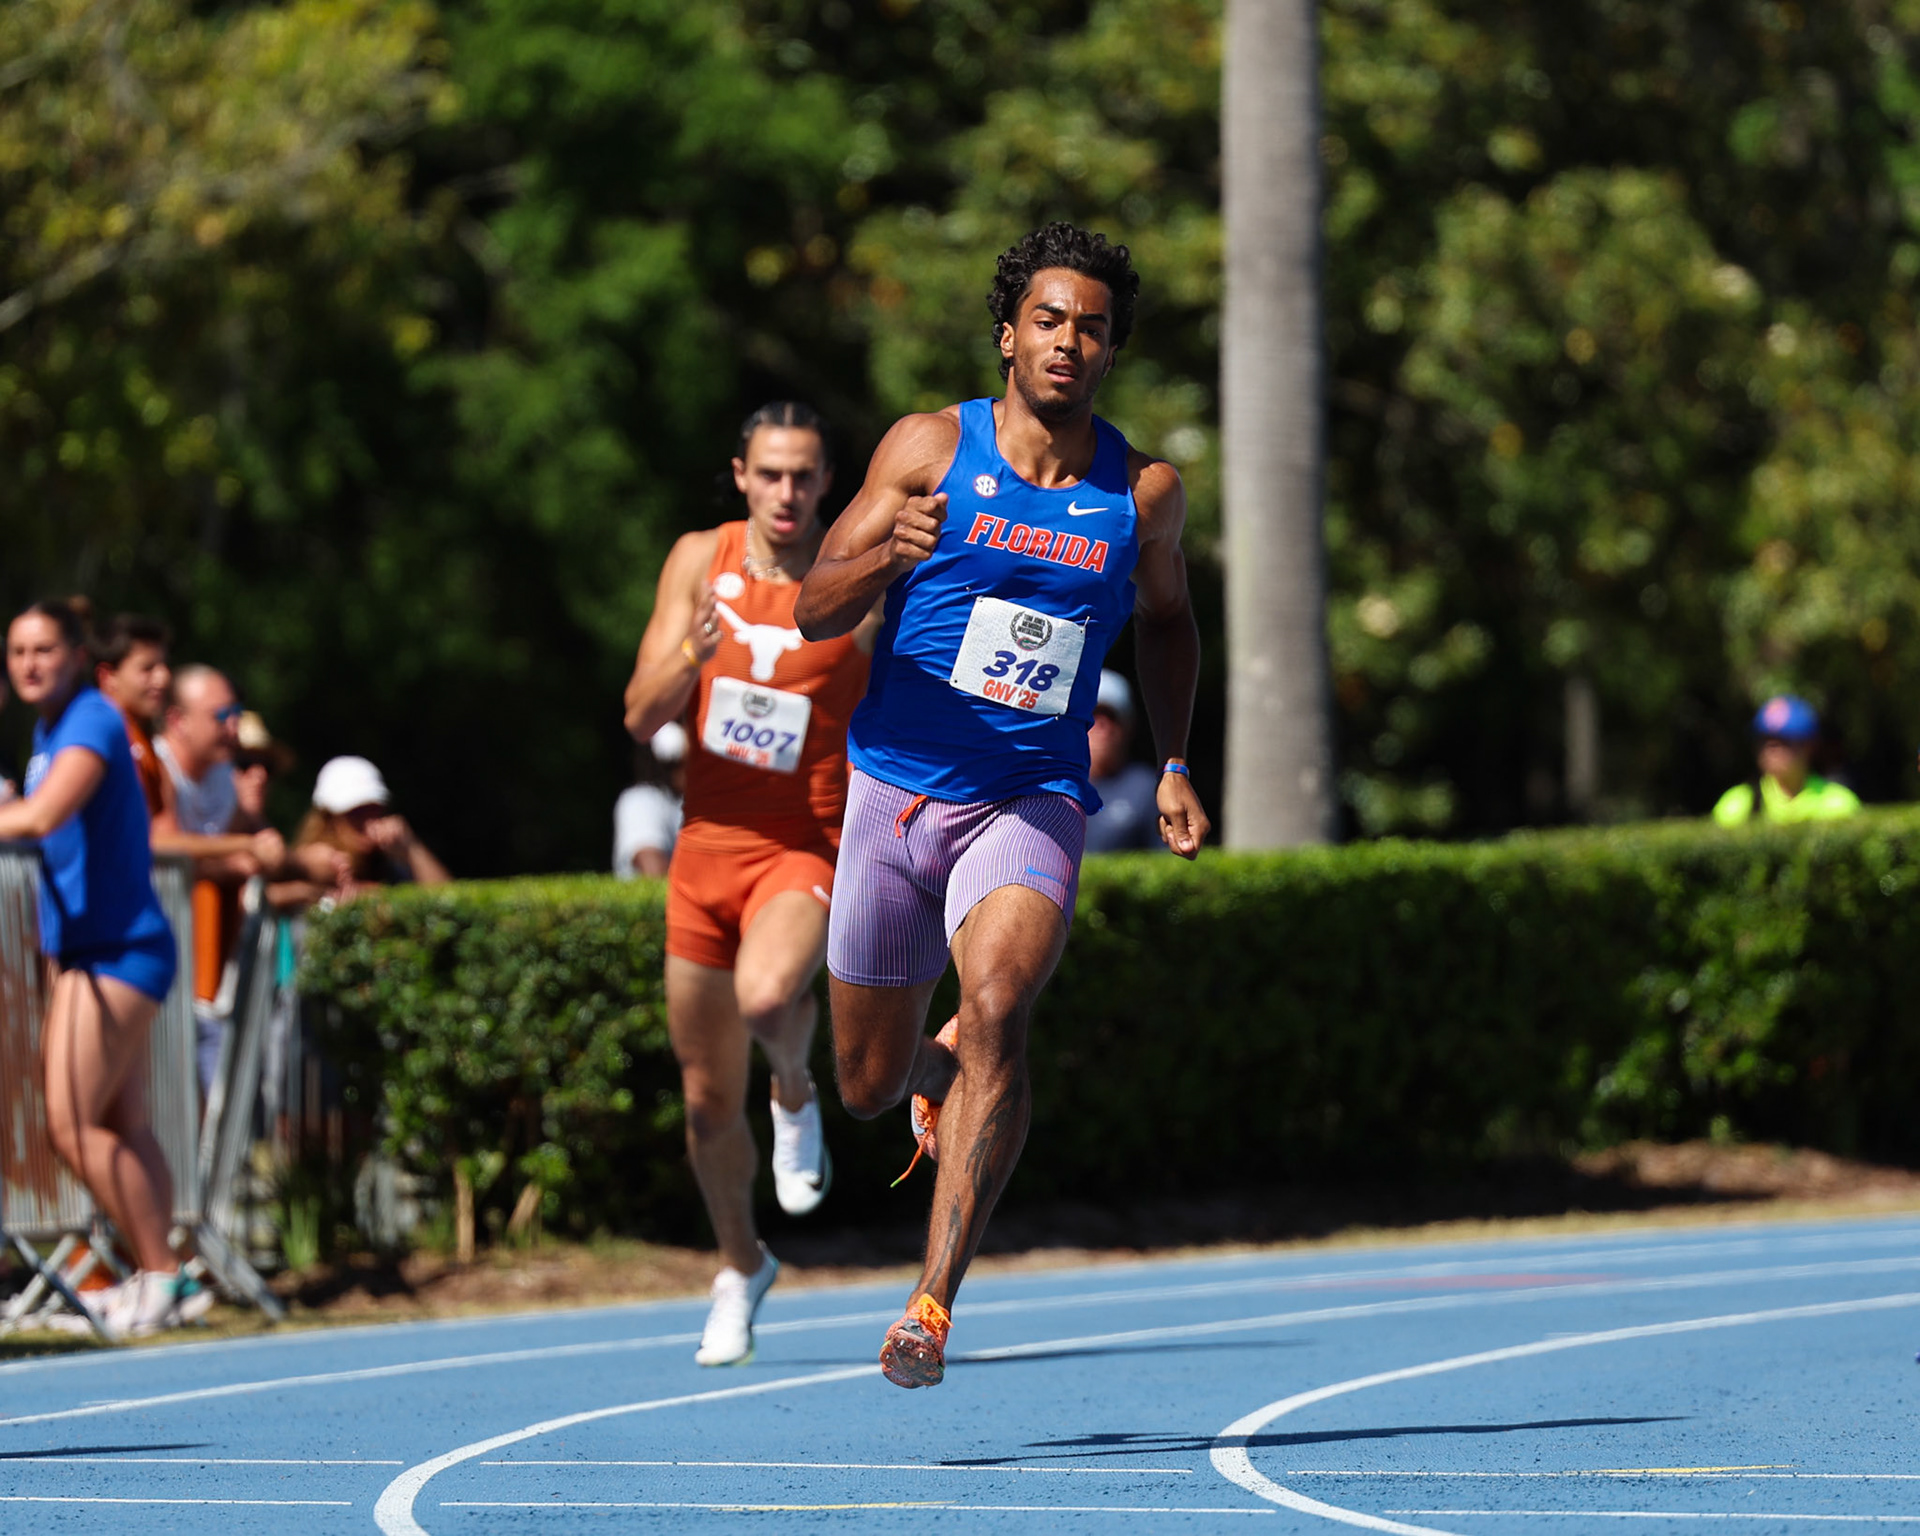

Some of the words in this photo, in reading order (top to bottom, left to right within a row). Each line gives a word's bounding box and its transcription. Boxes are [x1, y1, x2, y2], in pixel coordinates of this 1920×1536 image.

[975, 475, 997, 496] SEC
[964, 511, 1109, 573] FLORIDA
[982, 650, 1060, 691] 318
[983, 679, 1018, 702] GNV
[1018, 690, 1039, 709] '25
[721, 719, 798, 753] 1007
